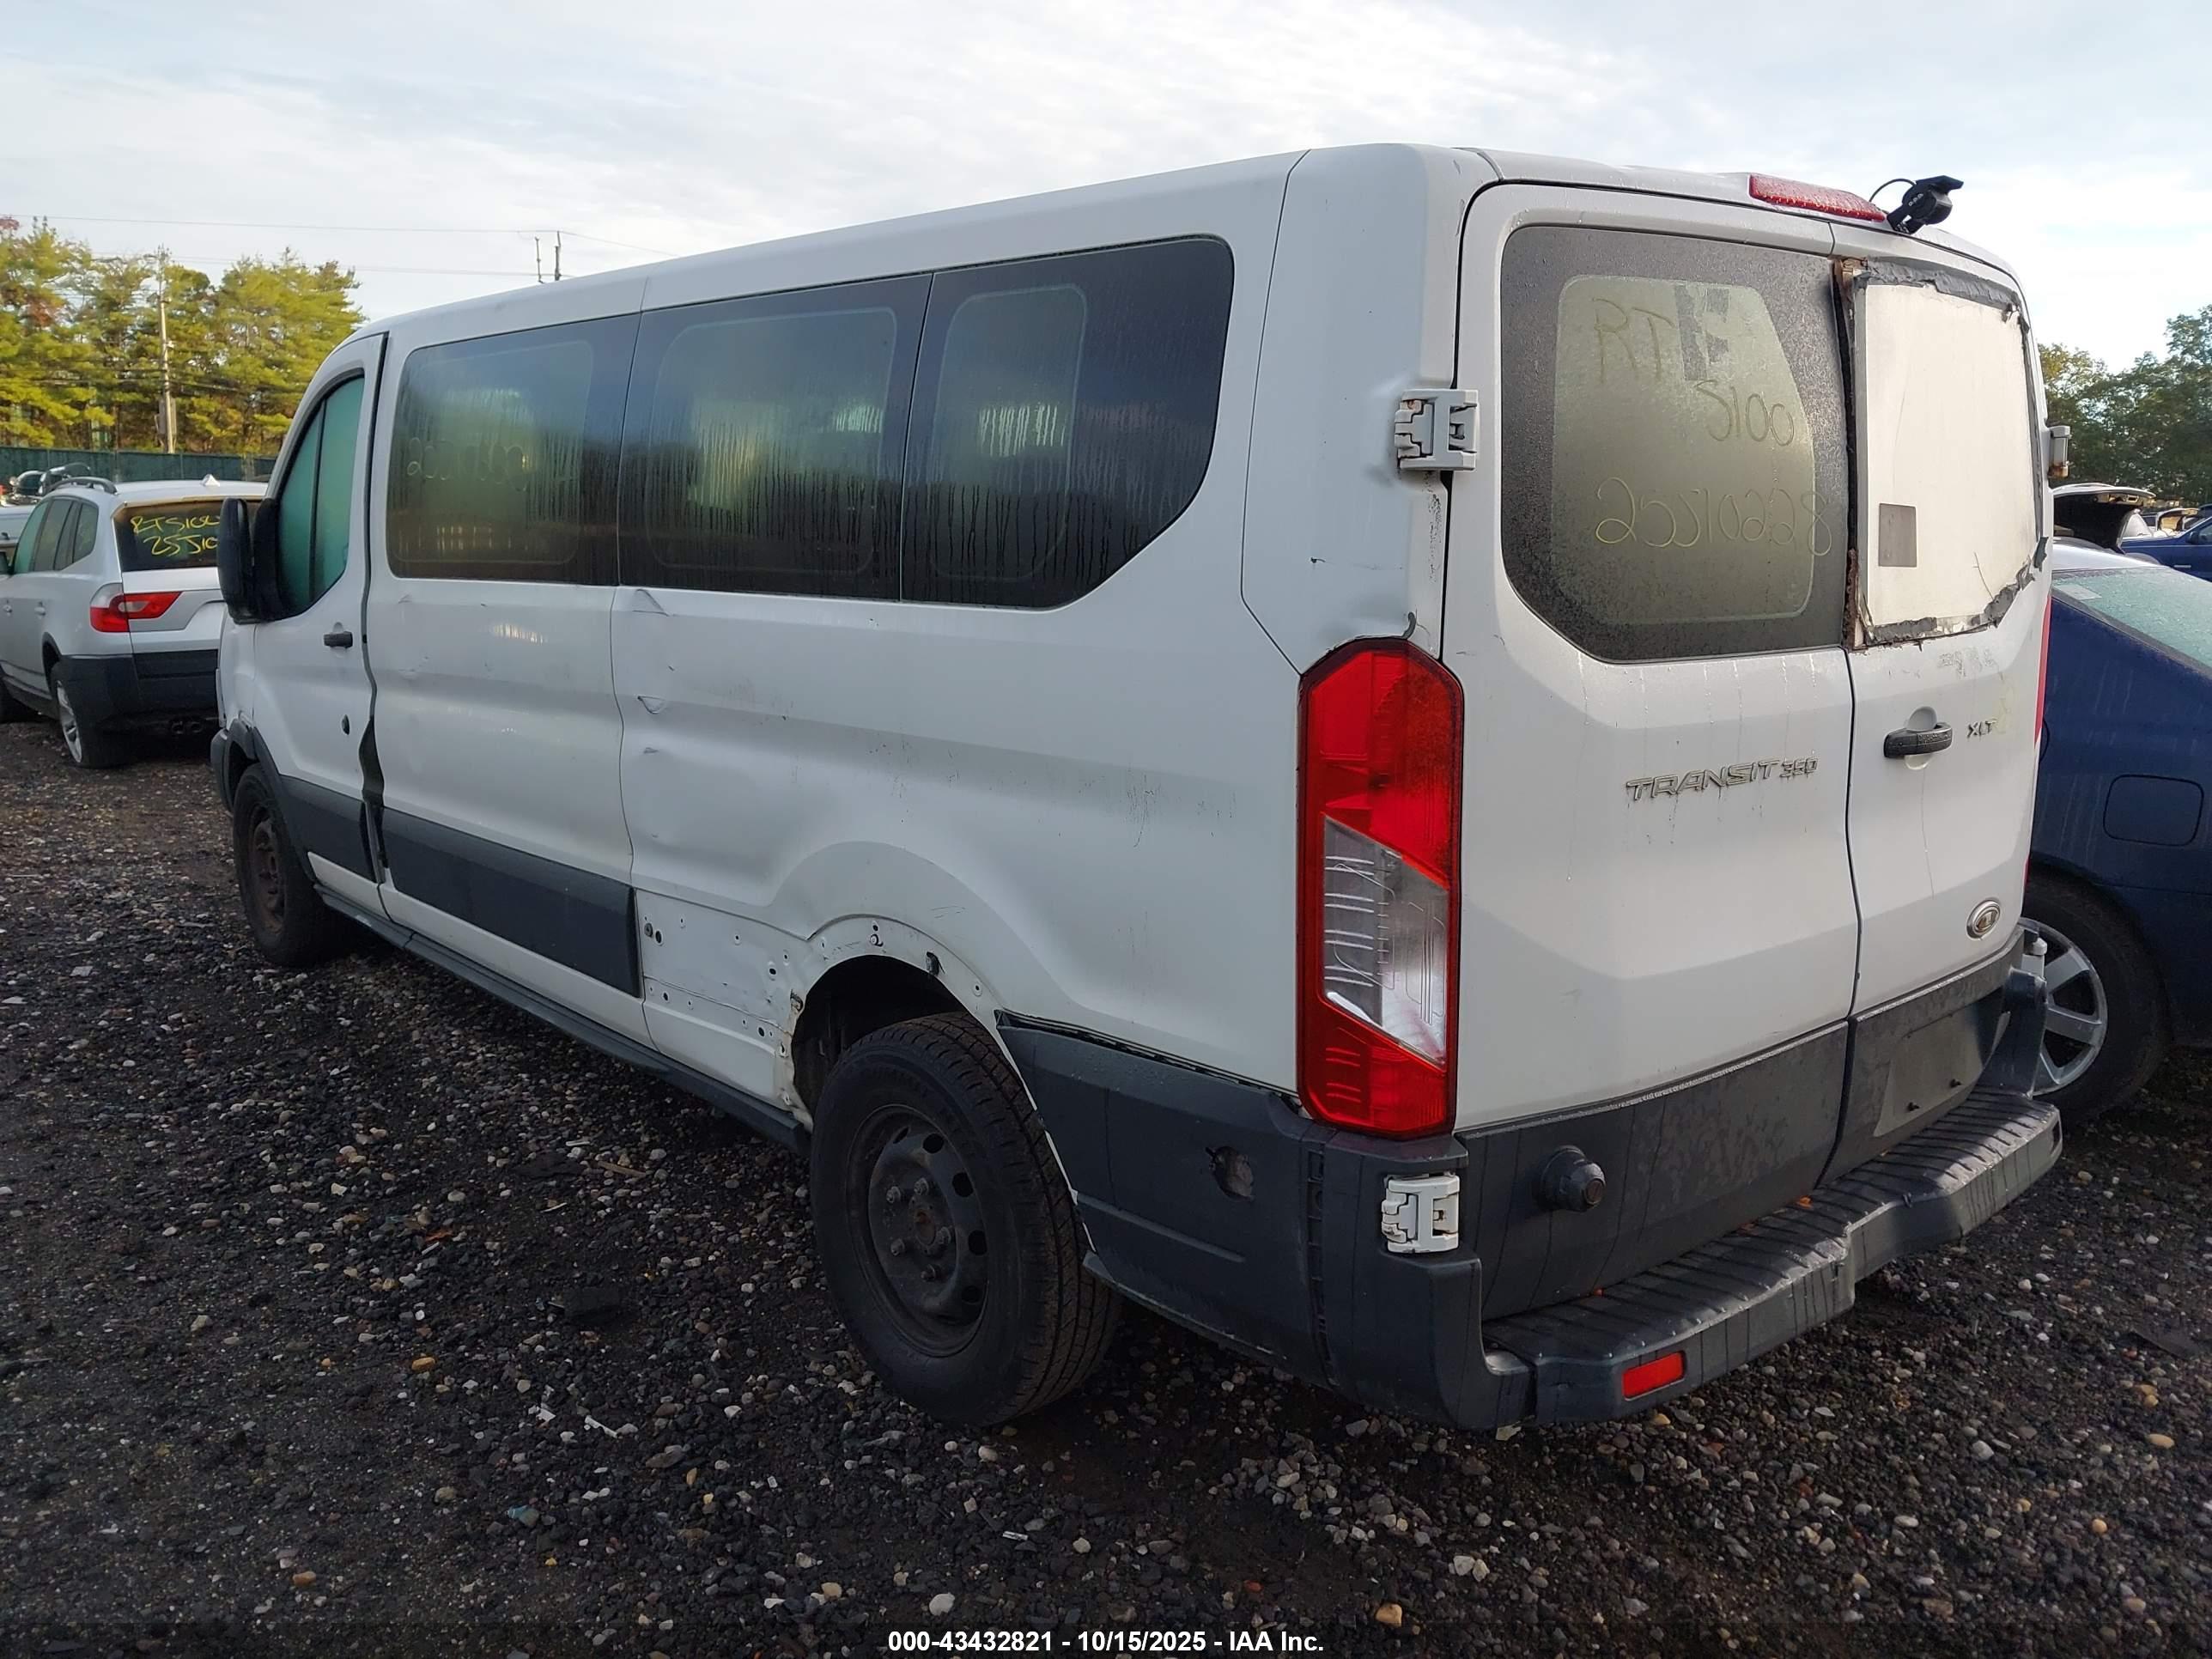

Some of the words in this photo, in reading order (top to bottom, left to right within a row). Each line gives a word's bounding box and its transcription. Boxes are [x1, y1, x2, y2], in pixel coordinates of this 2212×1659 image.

[1592, 297, 1675, 384] RT
[1966, 718, 1998, 738] XLT
[1626, 759, 1779, 801] TRANSIT
[1779, 757, 1819, 779] 350
